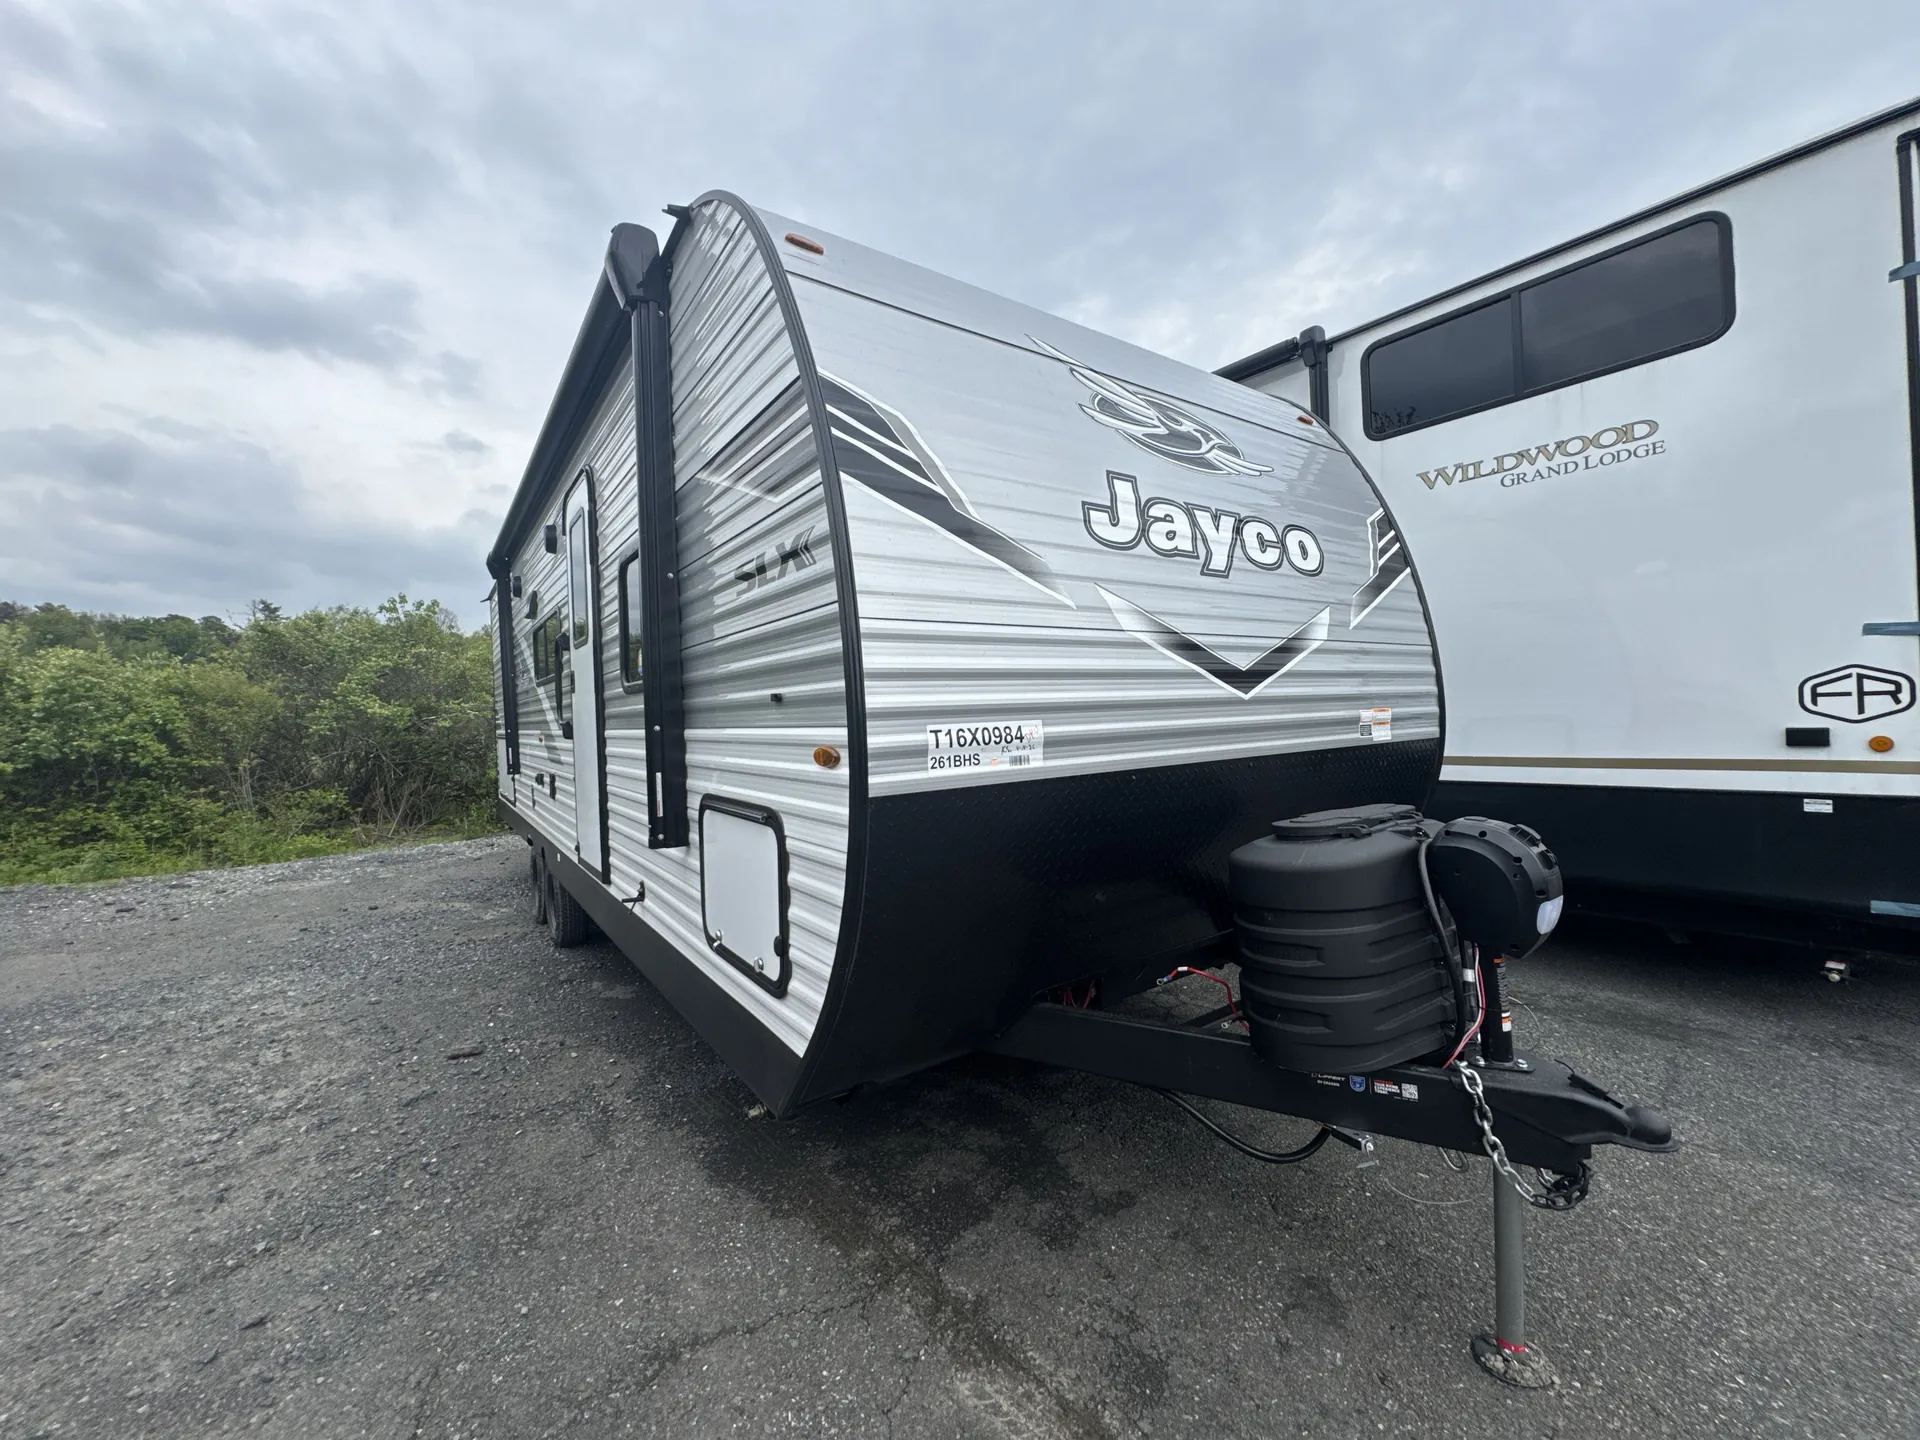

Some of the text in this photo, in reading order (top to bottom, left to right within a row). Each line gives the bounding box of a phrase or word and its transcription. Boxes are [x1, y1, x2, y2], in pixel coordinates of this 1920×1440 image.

[1416, 419, 1660, 490] WILDWOOD
[1500, 440, 1667, 488] GRAND LODGE
[1081, 470, 1324, 579] Jayco
[734, 525, 817, 598] SLX
[1811, 672, 1903, 715] FR
[929, 725, 1025, 749] T16X0984
[930, 753, 981, 770] 261BHS
